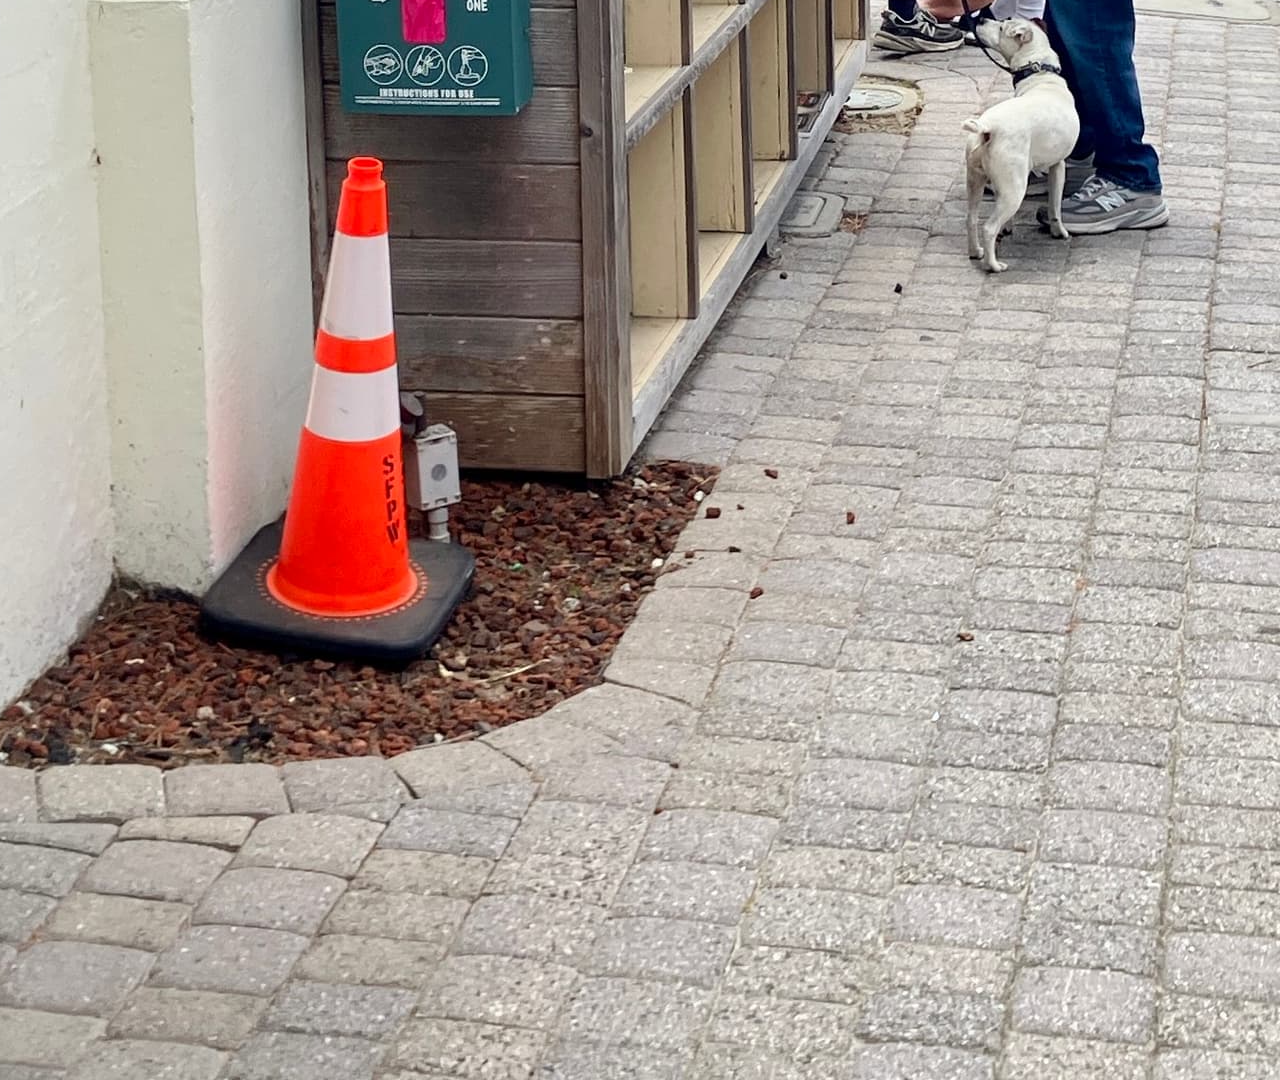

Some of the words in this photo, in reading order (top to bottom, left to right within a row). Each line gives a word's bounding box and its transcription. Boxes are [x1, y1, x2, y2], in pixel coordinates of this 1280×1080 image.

[466, 0, 489, 12] ONE
[379, 88, 439, 98] INSTRUCTIONS
[440, 89, 457, 98] FOR
[457, 89, 474, 98] USE
